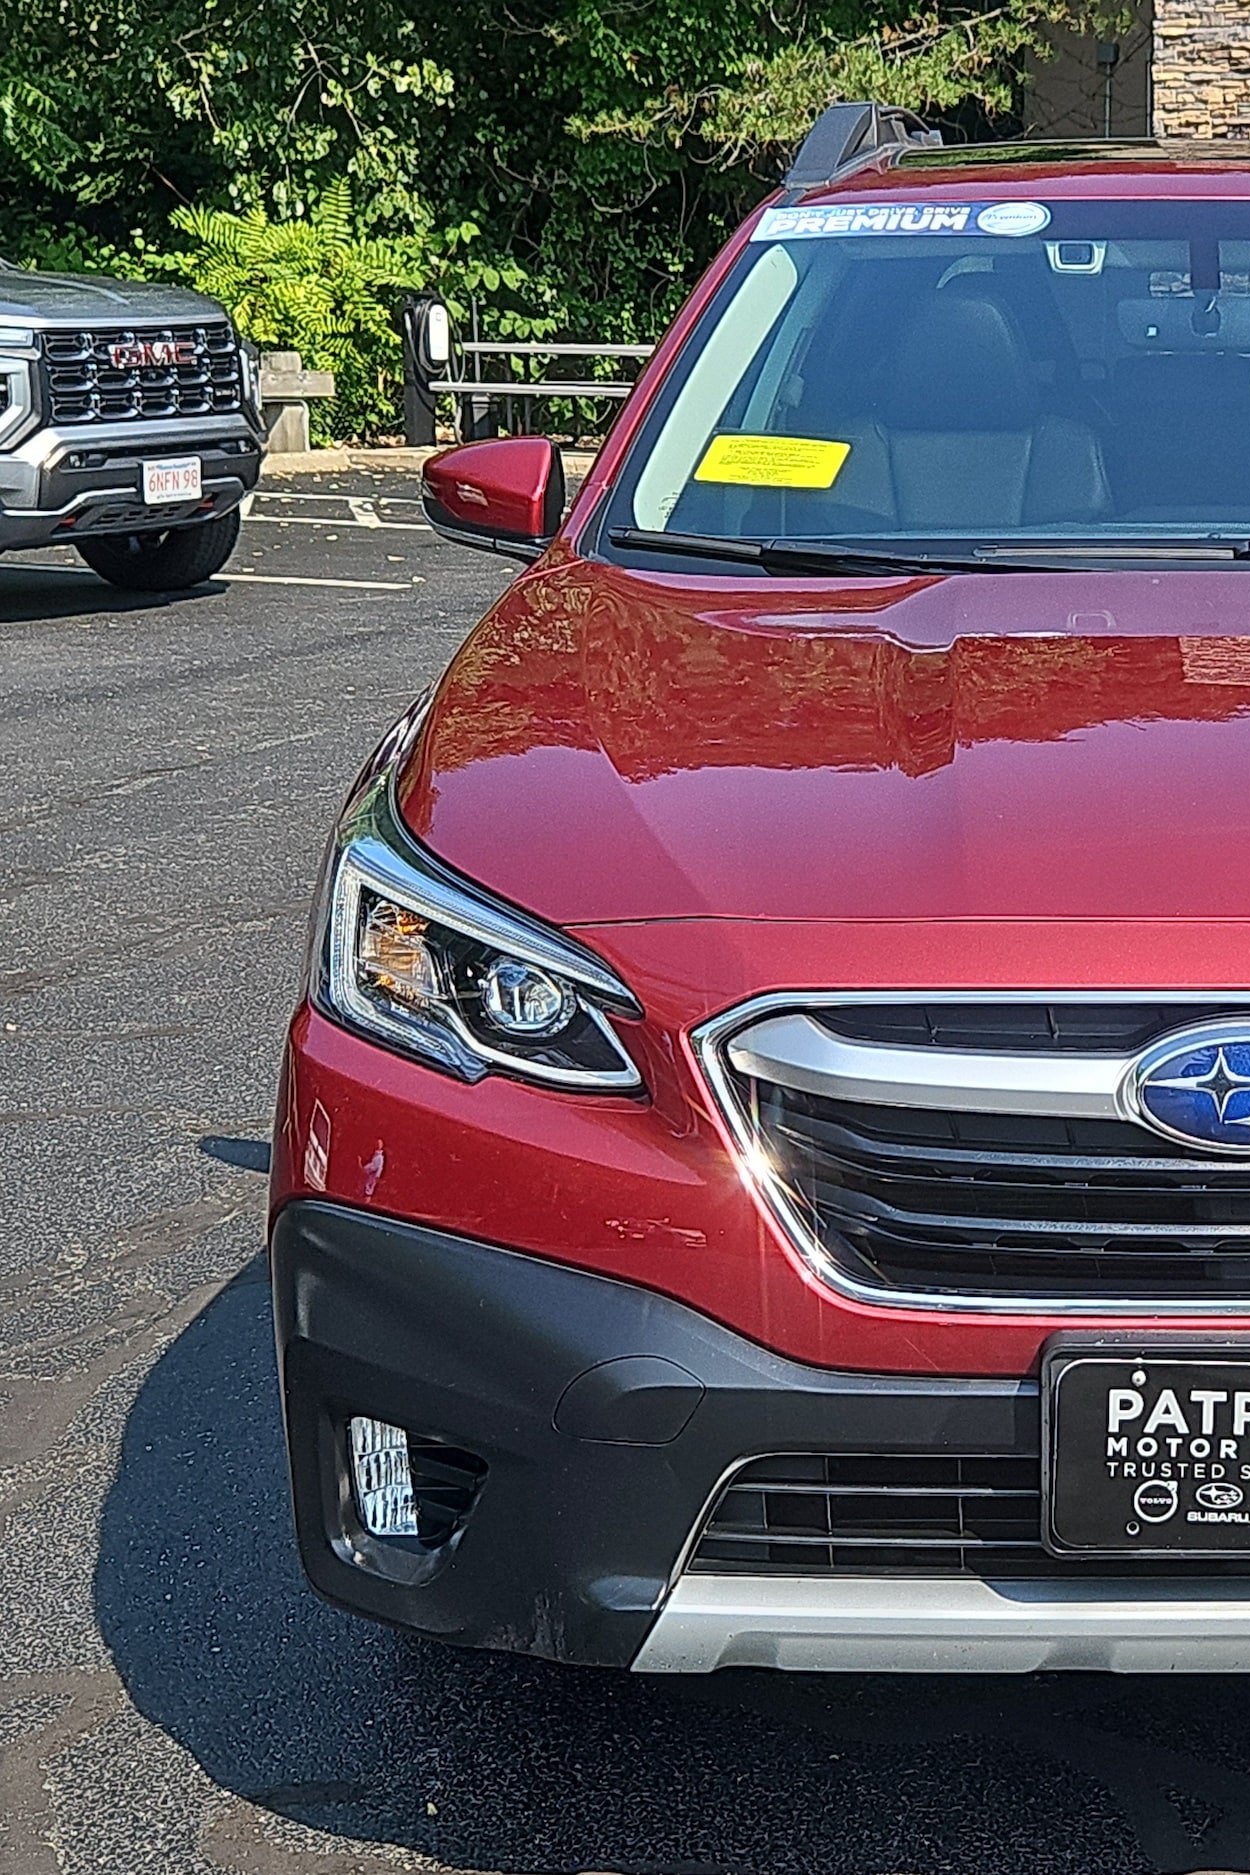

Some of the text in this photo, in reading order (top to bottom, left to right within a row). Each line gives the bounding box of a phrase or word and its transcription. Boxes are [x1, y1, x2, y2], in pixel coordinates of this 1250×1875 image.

[766, 213, 969, 235] PREMIUM
[108, 341, 198, 369] GMC
[149, 469, 198, 492] 6NFN 98
[1106, 1436, 1238, 1460] MOTOR
[1106, 1461, 1226, 1480] TRUSTED
[1139, 1497, 1173, 1505] VOLVO
[1187, 1511, 1250, 1523] SUBARU
